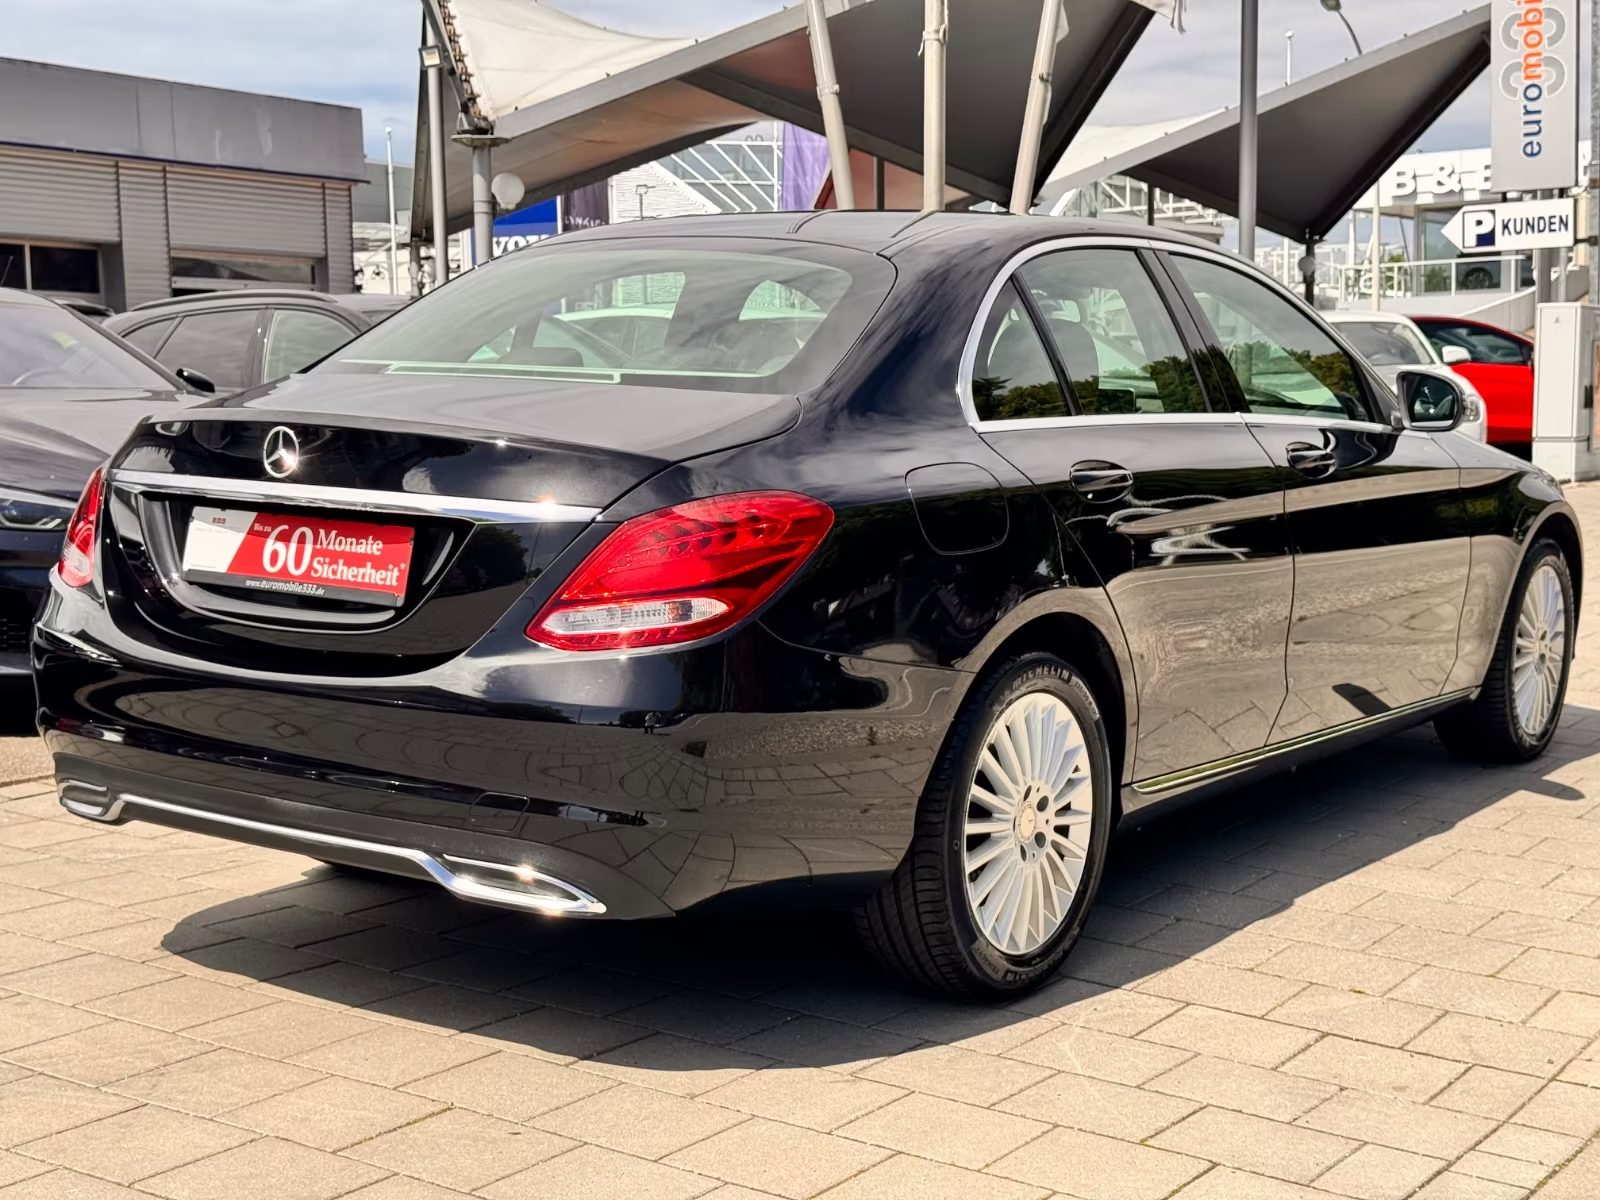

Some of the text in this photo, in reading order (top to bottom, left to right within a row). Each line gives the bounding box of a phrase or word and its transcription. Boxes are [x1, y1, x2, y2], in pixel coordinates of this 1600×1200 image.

[1464, 211, 1569, 247] P KUNDEN
[262, 524, 314, 576] 60
[315, 528, 383, 556] Monate
[245, 579, 325, 596] www.euromobile333.de
[1012, 664, 1070, 691] MICHELIN
